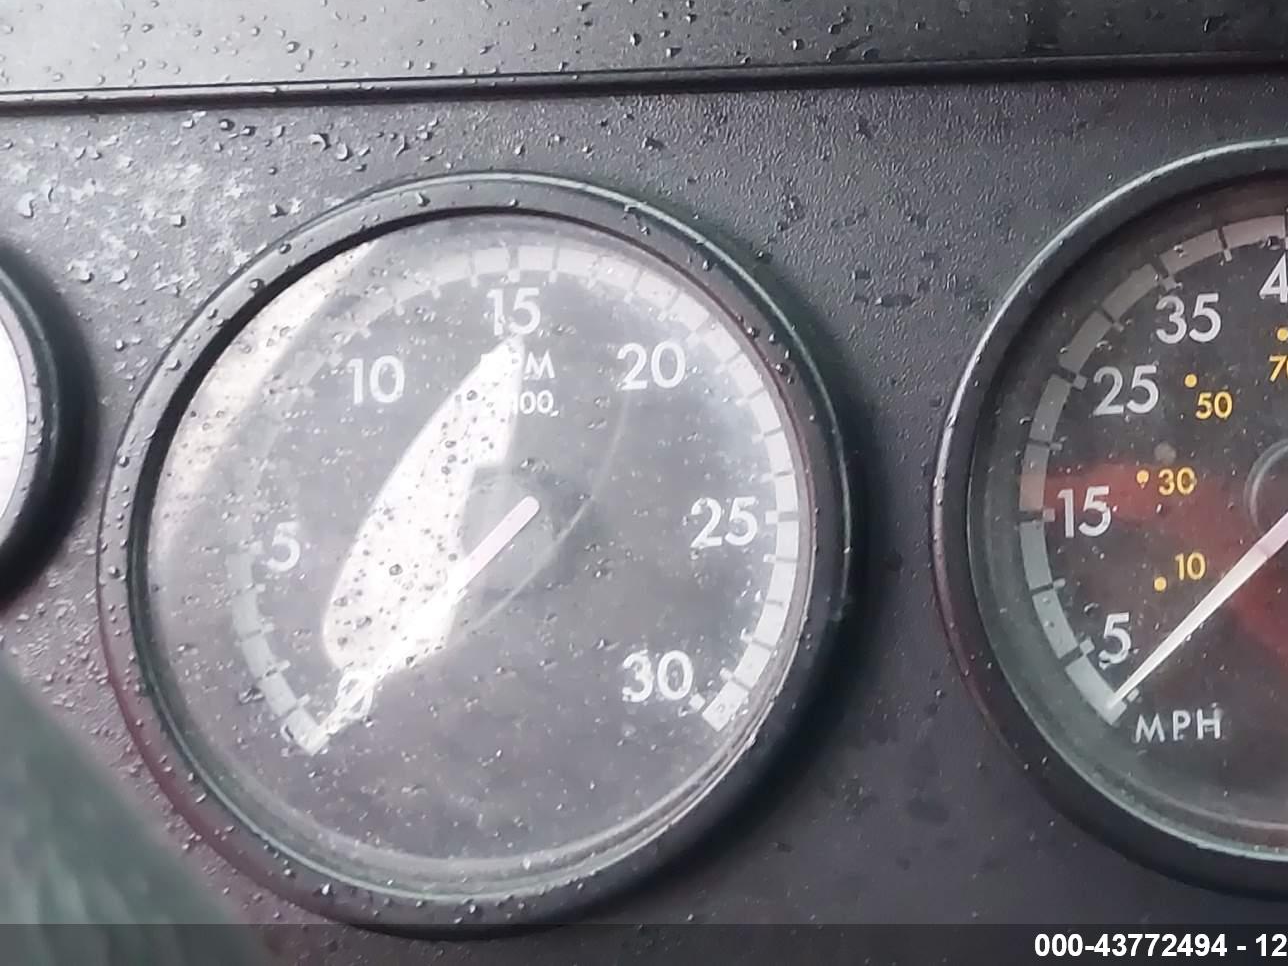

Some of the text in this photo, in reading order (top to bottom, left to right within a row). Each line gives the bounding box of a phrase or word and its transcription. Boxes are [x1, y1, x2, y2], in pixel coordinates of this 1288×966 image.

[488, 287, 541, 335] 15
[1155, 293, 1222, 344] 35
[347, 357, 405, 405] 10
[617, 342, 686, 391] 20
[1092, 365, 1160, 416] 25
[1196, 391, 1233, 419] 50
[1158, 468, 1195, 496] 30
[690, 497, 759, 548] 25
[1057, 487, 1112, 538] 15
[266, 521, 301, 572] 5
[1175, 553, 1206, 581] 10
[1101, 614, 1132, 665] 5
[622, 650, 694, 704] 30
[1134, 710, 1222, 743] MPH
